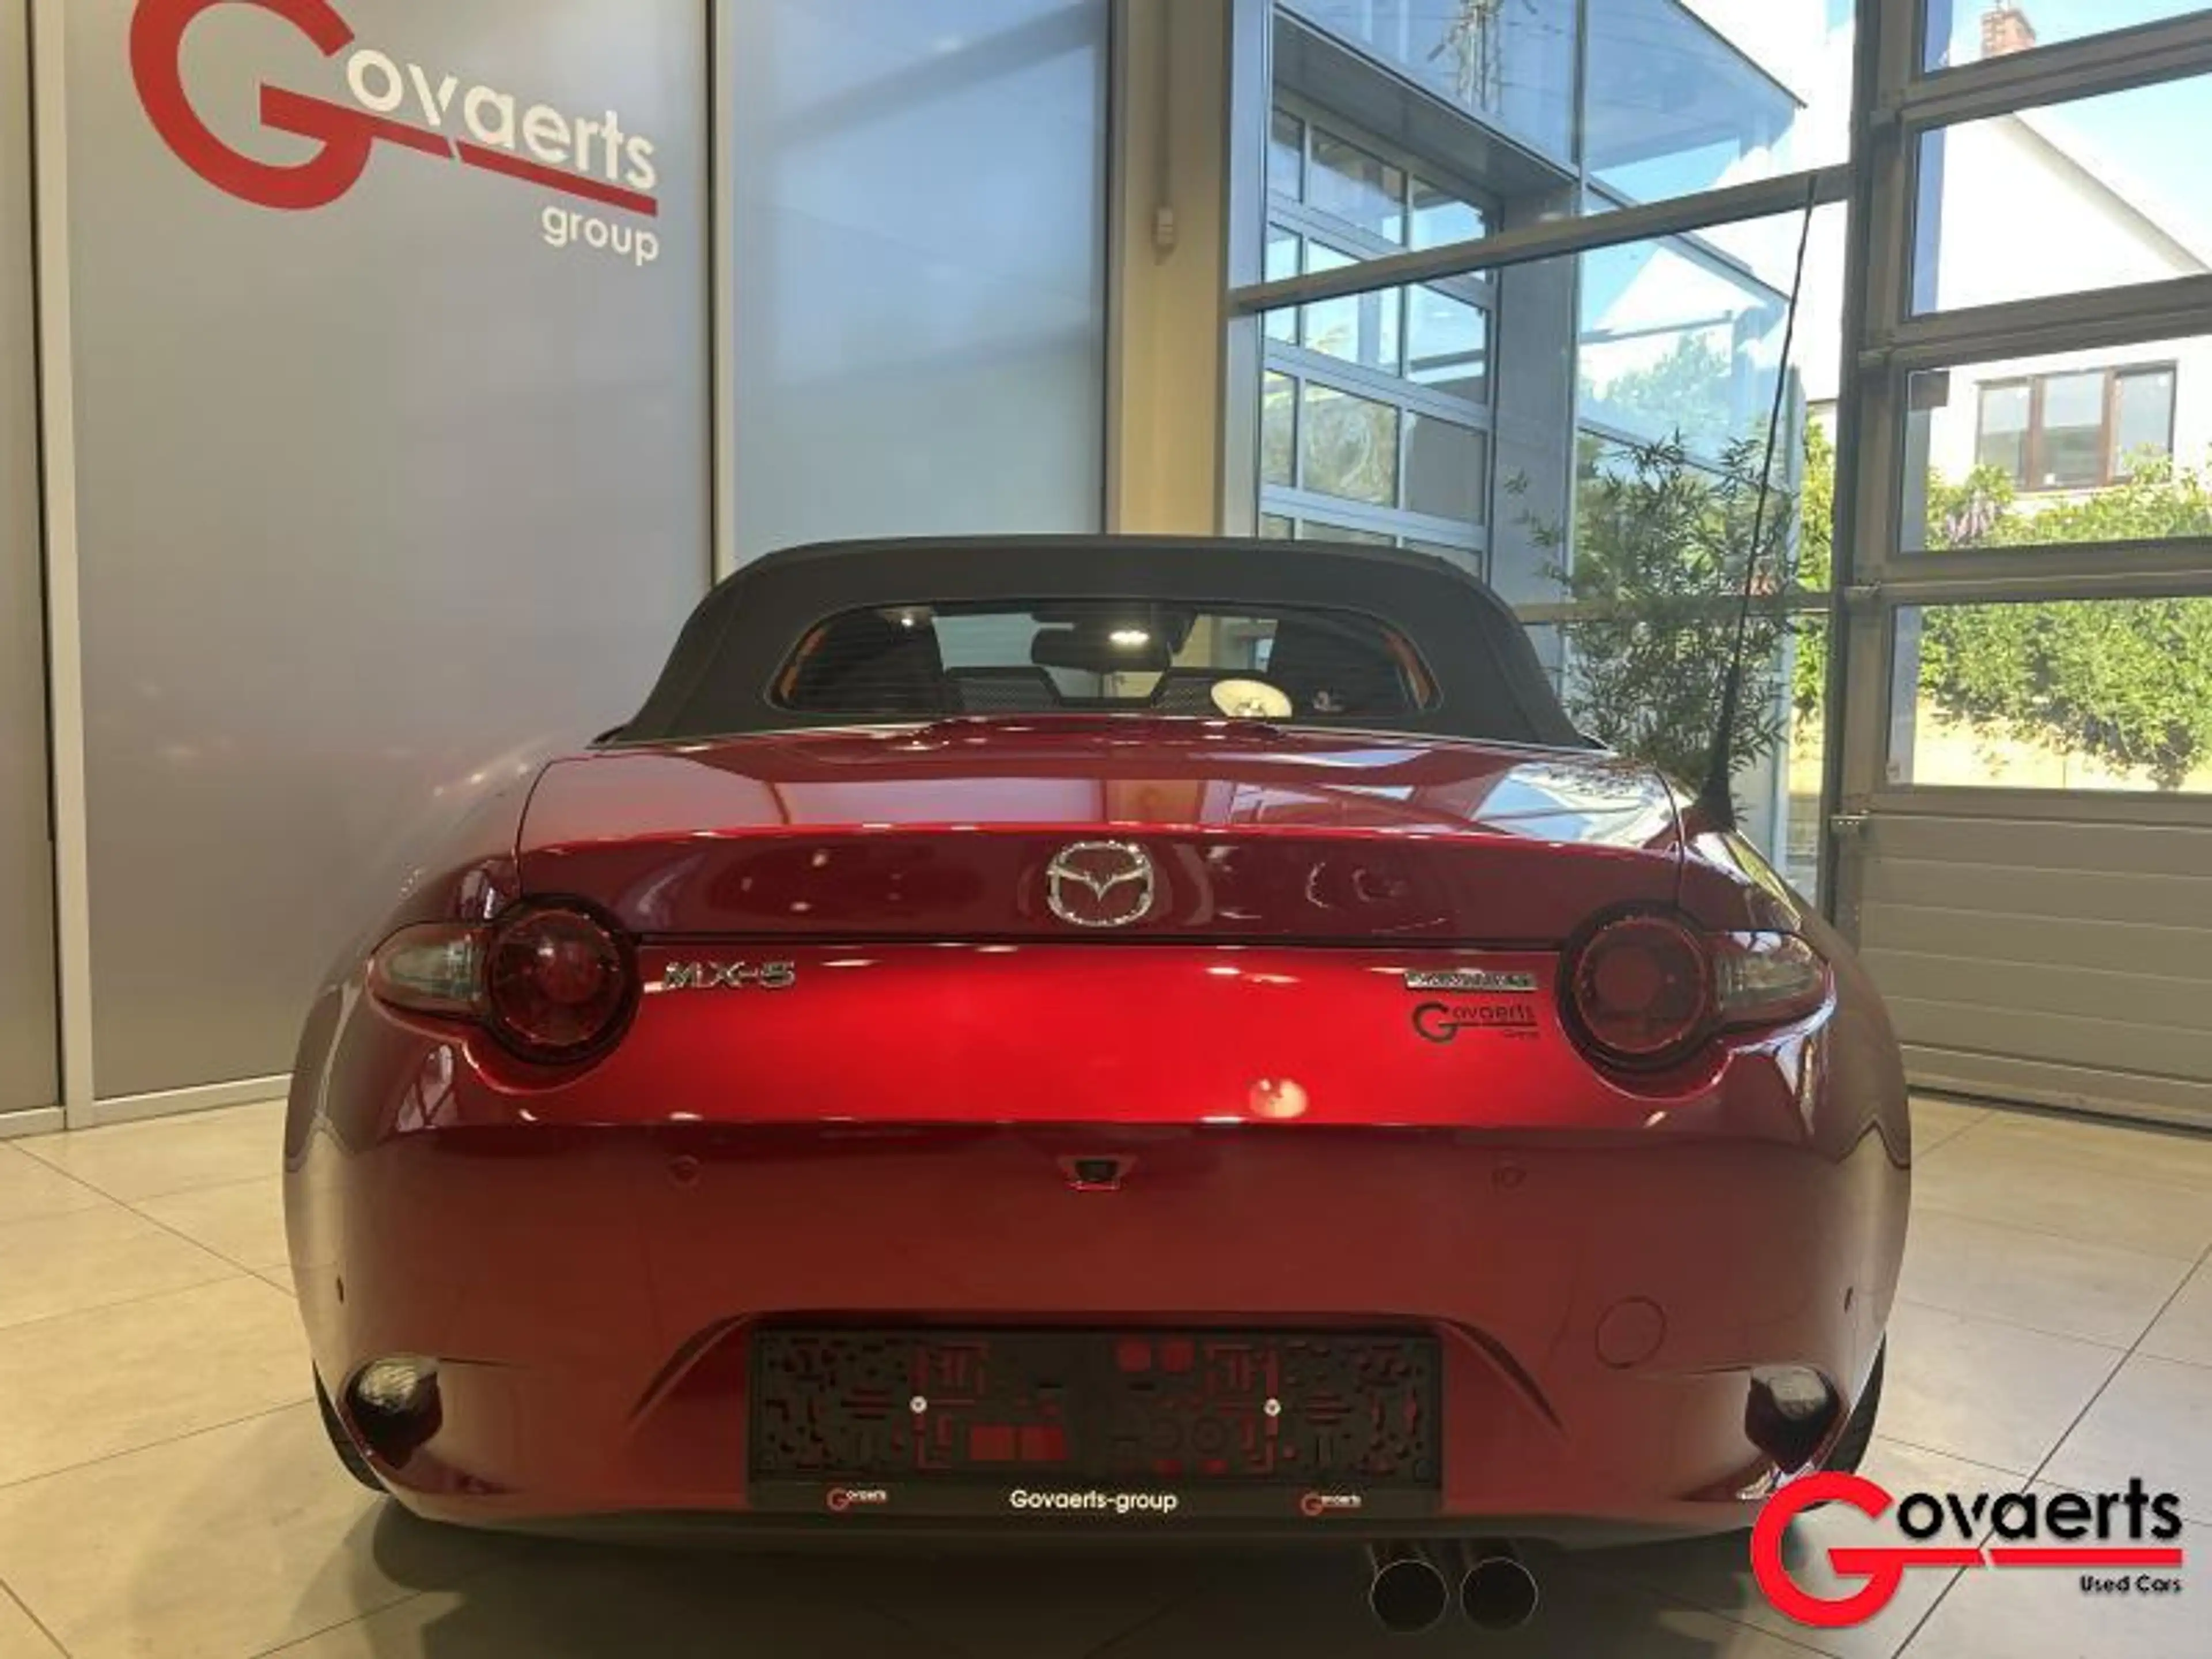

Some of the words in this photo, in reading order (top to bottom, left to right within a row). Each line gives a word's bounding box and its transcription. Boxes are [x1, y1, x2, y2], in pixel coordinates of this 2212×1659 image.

[130, 0, 657, 215] Govaerts
[541, 206, 660, 266] group
[665, 961, 795, 988] MX-5
[1009, 1490, 1179, 1513] Govaerts-group
